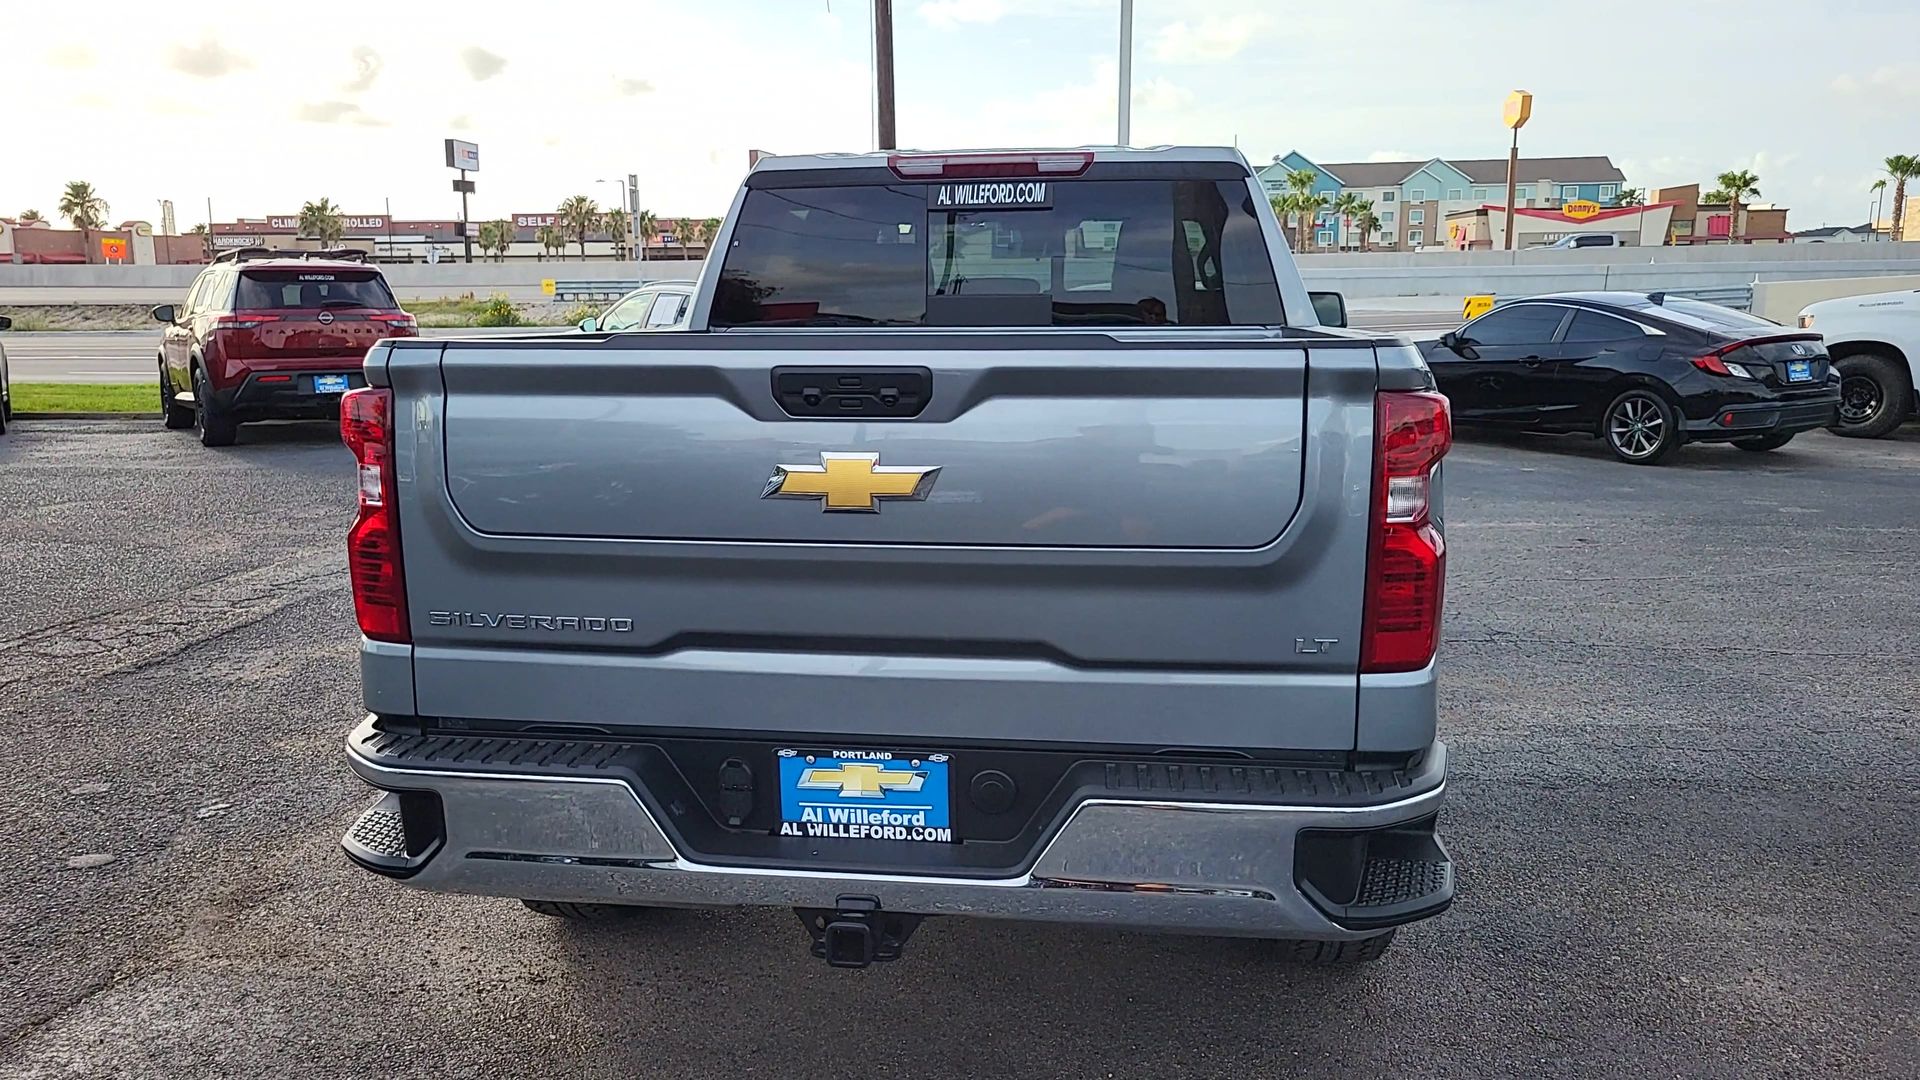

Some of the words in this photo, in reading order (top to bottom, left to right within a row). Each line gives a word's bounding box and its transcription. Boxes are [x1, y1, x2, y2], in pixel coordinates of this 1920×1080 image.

[937, 185, 952, 206] AL
[954, 183, 1046, 205] WILLEFORD.COM
[1567, 204, 1596, 214] Denny's
[517, 216, 555, 227] SELF
[429, 611, 634, 632] SILVERADO
[1295, 638, 1339, 654] LT
[832, 750, 893, 761] PORTLAND
[800, 807, 824, 823] Al
[829, 808, 925, 826] Willeford
[780, 822, 803, 836] AL
[807, 823, 952, 842] WILLEFORD.COM
